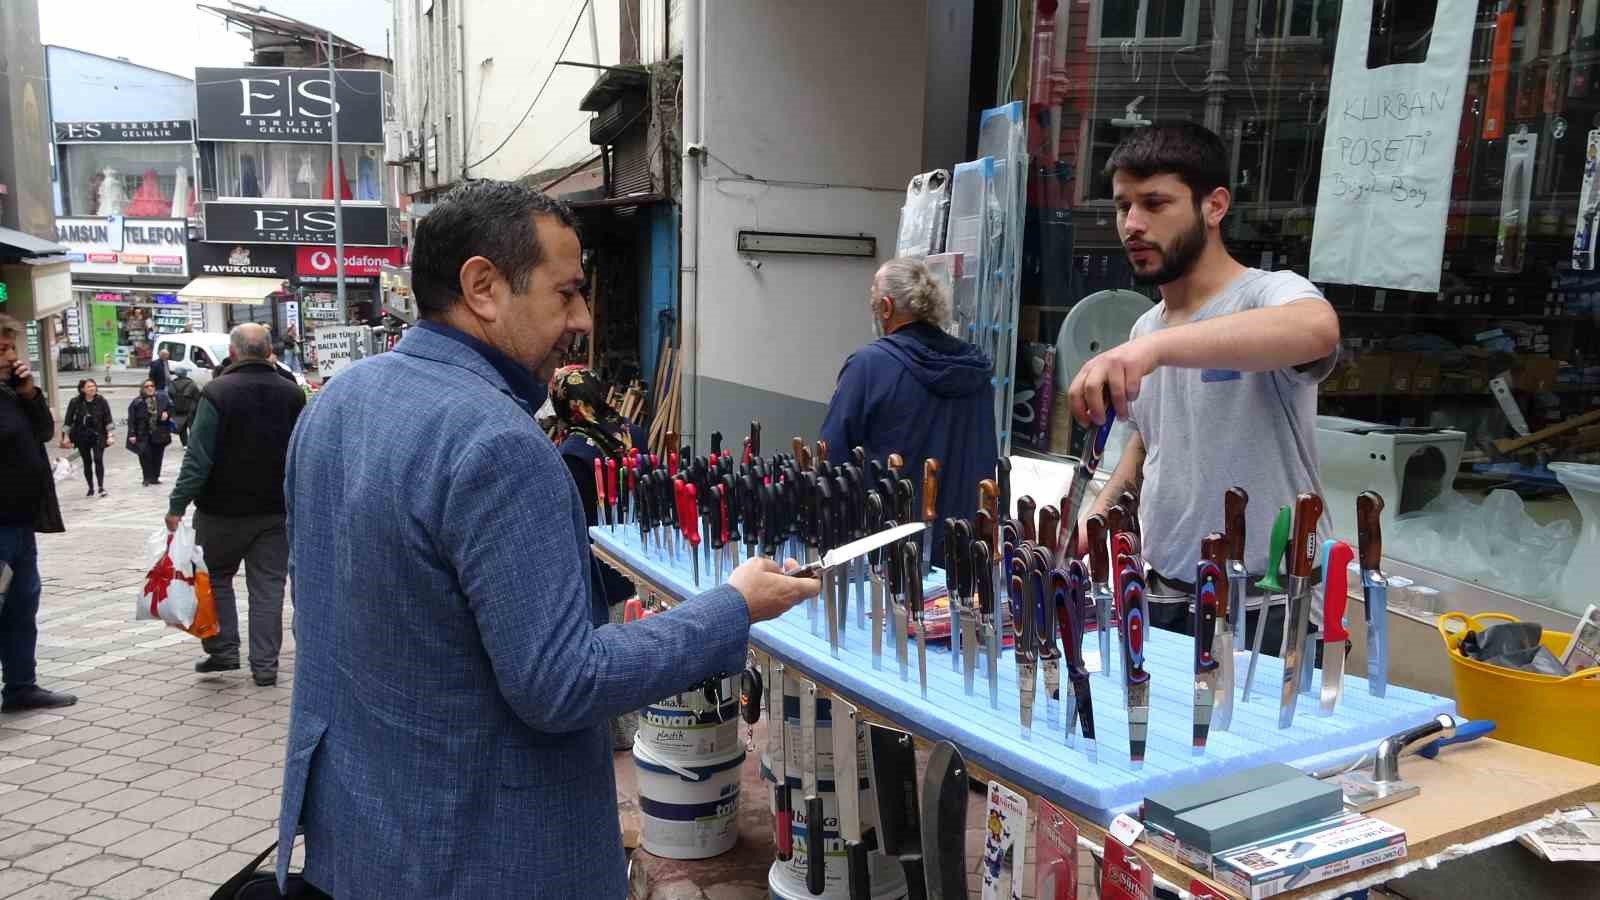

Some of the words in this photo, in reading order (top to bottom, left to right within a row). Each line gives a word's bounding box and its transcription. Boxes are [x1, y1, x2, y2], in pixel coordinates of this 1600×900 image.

[124, 226, 185, 245] TELEFON
[333, 255, 390, 266] vodafone
[203, 264, 277, 274] TAVUKÇULUK
[646, 710, 697, 728] tavan
